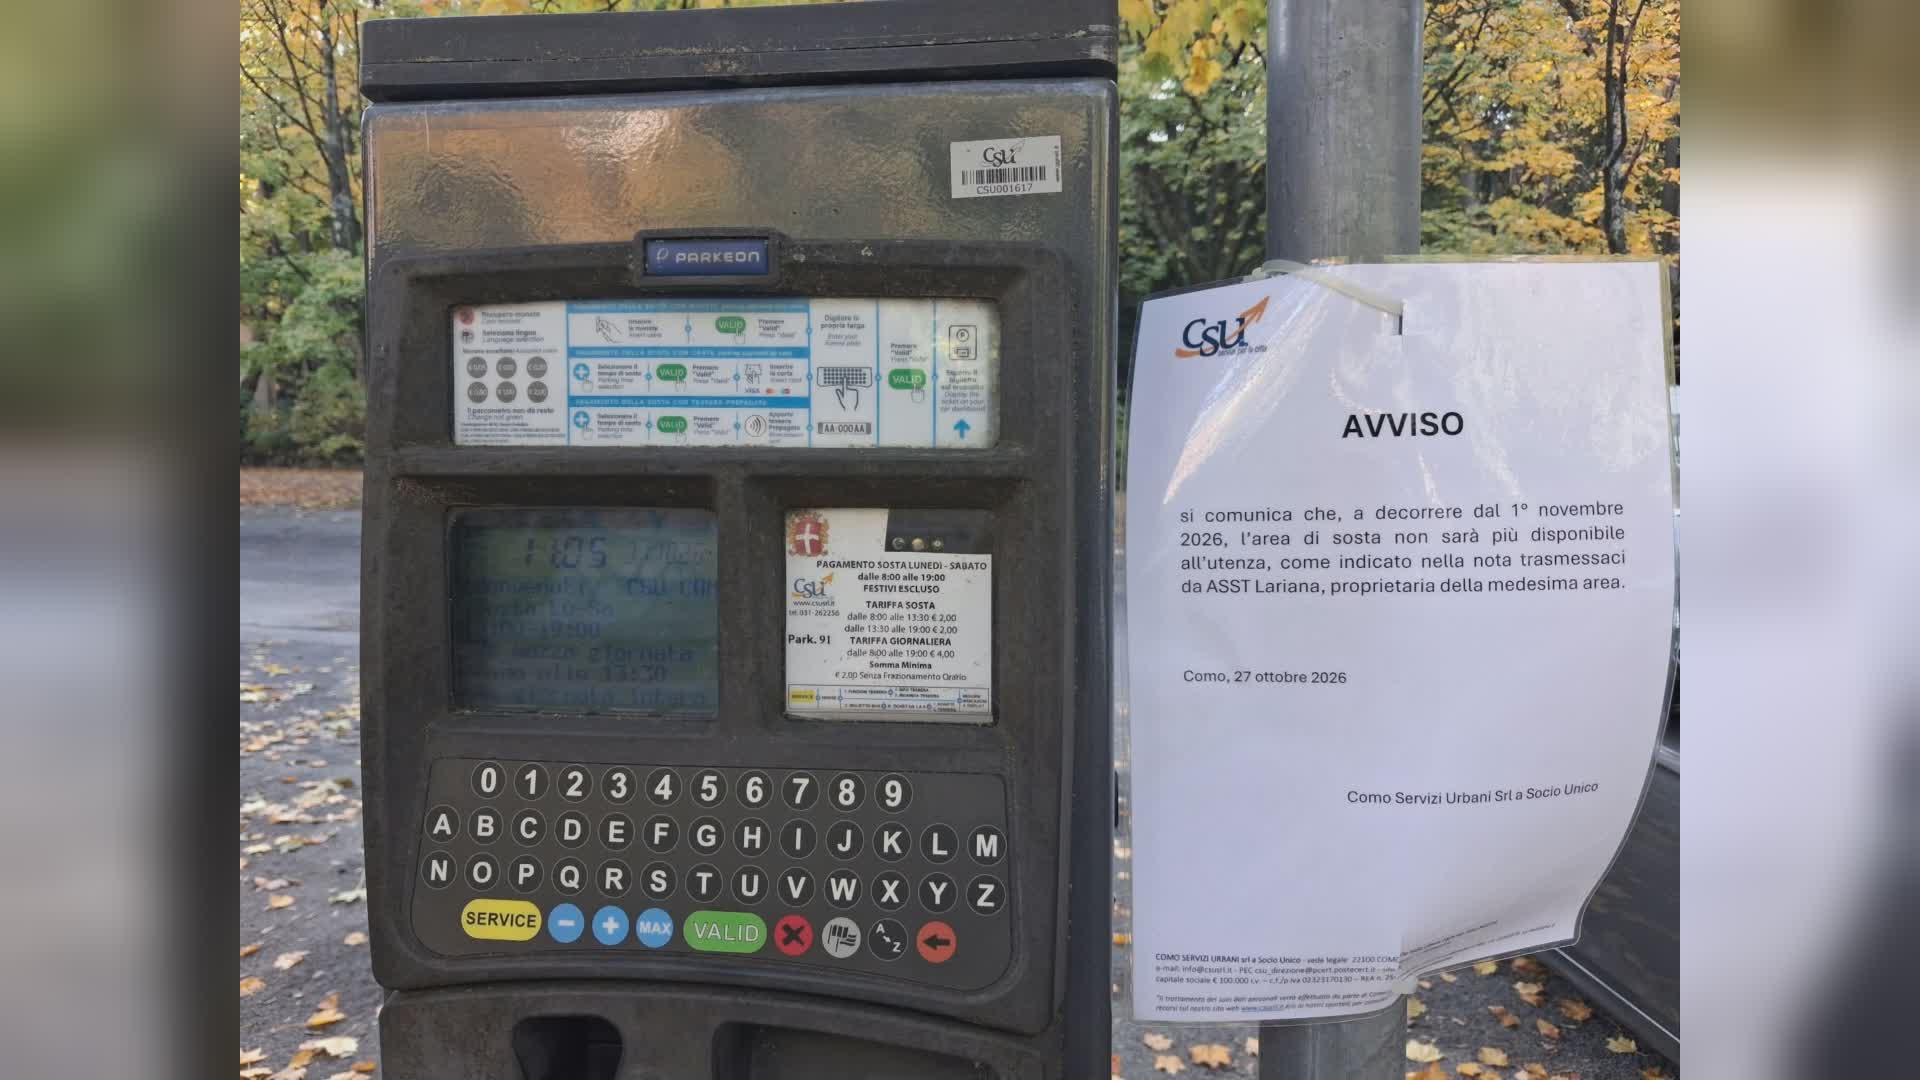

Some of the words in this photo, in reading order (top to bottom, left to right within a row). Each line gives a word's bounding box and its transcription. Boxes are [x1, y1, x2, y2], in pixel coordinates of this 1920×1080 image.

[977, 184, 1032, 194] CSU001617
[676, 252, 759, 264] PARKEON
[659, 369, 684, 377] VALID
[892, 376, 922, 384] VALID
[1342, 412, 1463, 438] AVVISO
[1181, 509, 1193, 522] si
[1205, 508, 1291, 522] comunica
[1304, 507, 1341, 522] che,
[1354, 509, 1363, 520] a
[1376, 506, 1462, 519] decorrere
[1474, 504, 1500, 518] dal
[1512, 504, 1527, 517] 1°
[1539, 501, 1623, 516] novembre
[1181, 533, 1227, 547] 2026,
[1304, 531, 1318, 544] di
[1333, 532, 1380, 544] sosta
[1395, 533, 1427, 544] non
[1442, 528, 1478, 543] sarà
[1493, 528, 1517, 545] più
[1531, 526, 1624, 544] disponibile
[817, 560, 875, 568] PAGAMENTO
[878, 561, 906, 569] SOSTA
[950, 562, 987, 570] SABATO
[1281, 558, 1330, 569] come
[1340, 555, 1411, 568] indicato
[1422, 554, 1463, 568] nella
[1474, 554, 1511, 567] nota
[1520, 550, 1625, 566] trasmessaci
[858, 572, 879, 580] dalle
[903, 573, 918, 581] alle
[899, 585, 939, 593] ESCLUSO
[1182, 580, 1201, 593] da
[1207, 580, 1250, 593] ASST
[1256, 579, 1325, 594] Lariana,
[1331, 579, 1434, 596] proprietaria
[1441, 578, 1482, 592] della
[1489, 576, 1577, 591] medesima
[1583, 578, 1624, 589] area.
[848, 612, 867, 620] dalle
[870, 613, 887, 621] 8:00
[890, 613, 904, 621] alle
[939, 614, 956, 623] 2,00
[844, 624, 864, 632] dalle
[868, 625, 889, 633] 13:30
[892, 625, 905, 633] alle
[940, 626, 957, 634] 2,00
[788, 634, 816, 644] Park.
[820, 636, 830, 644] 91
[890, 637, 951, 646] GIORNALIERA
[847, 648, 867, 657] dalle
[889, 649, 903, 657] alle
[937, 650, 954, 658] 4,00
[884, 672, 941, 680] Frazionamento
[1184, 670, 1230, 683] Como,
[1234, 671, 1251, 682] 27
[1255, 672, 1307, 683] ottobre
[1312, 672, 1346, 683] 2026
[481, 768, 496, 792] 0
[525, 770, 536, 794] 1
[566, 771, 583, 796] 2
[611, 773, 627, 798] 3
[655, 775, 672, 800] 4
[701, 776, 717, 801] 5
[746, 777, 763, 802] 6
[793, 778, 809, 804] 7
[839, 779, 855, 805] 8
[885, 780, 902, 807] 9
[1348, 791, 1391, 803] Como
[1396, 792, 1441, 804] Servizi
[1447, 792, 1491, 804] Urbani
[1495, 790, 1512, 801] Srl
[1516, 792, 1522, 800] a
[1526, 786, 1560, 799] Socio
[1564, 781, 1598, 795] Unico
[433, 814, 451, 834] A
[477, 815, 493, 836] B
[521, 817, 537, 838] C
[564, 819, 581, 840] D
[609, 821, 624, 842] E
[654, 823, 669, 844] F
[697, 825, 715, 846] G
[744, 827, 760, 848] H
[796, 828, 801, 850] I
[838, 830, 851, 851] J
[884, 831, 902, 853] K
[933, 833, 947, 855] L
[977, 834, 997, 857] M
[431, 860, 447, 881] N
[473, 862, 492, 883] O
[519, 864, 534, 884] P
[561, 866, 579, 889] Q
[606, 868, 623, 889] R
[651, 870, 666, 892] S
[696, 872, 712, 894] T
[742, 875, 758, 896] U
[787, 876, 805, 898] V
[831, 878, 856, 900] W
[881, 880, 899, 902] X
[929, 882, 947, 904] Y
[977, 884, 994, 907] Z
[466, 912, 536, 928] SERVICE
[639, 920, 671, 935] MAX
[694, 922, 759, 942] VALID
[876, 924, 885, 933] A
[893, 942, 900, 952] Z
